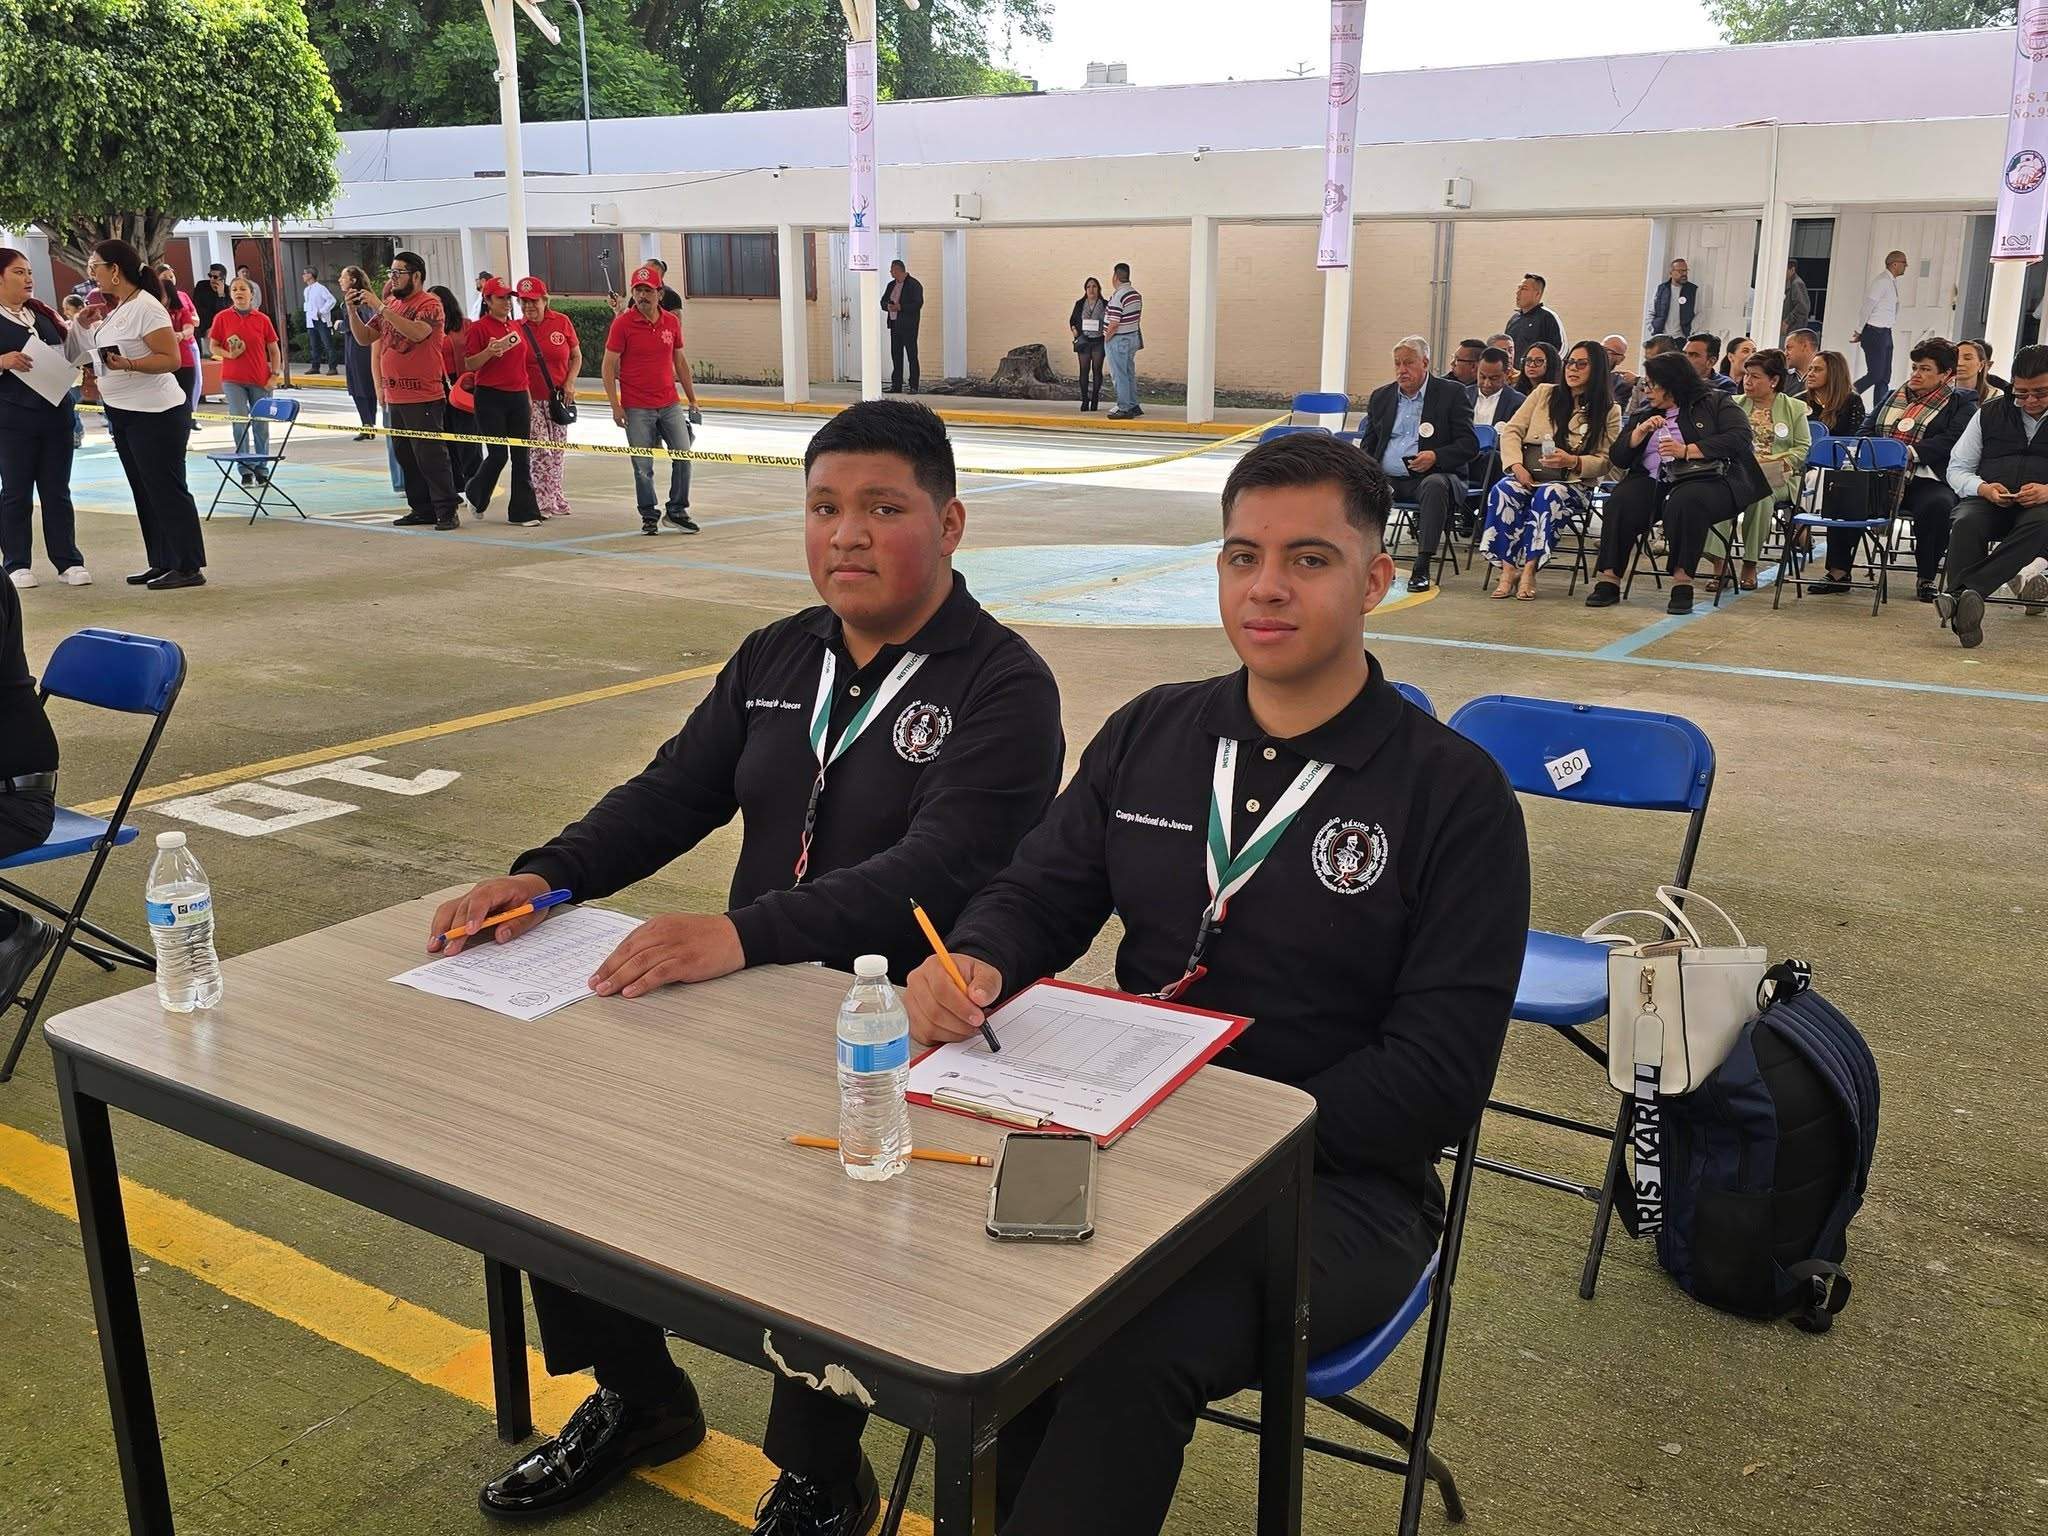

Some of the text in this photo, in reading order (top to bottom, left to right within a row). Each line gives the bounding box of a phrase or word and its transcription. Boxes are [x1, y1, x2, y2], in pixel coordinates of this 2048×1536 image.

[592, 445, 653, 456] PRECAUCION
[667, 449, 732, 462] PRECAUCION
[1552, 756, 1583, 780] 180
[1168, 820, 1192, 831] Jueces
[1341, 819, 1369, 832] MÉXICO
[1636, 1088, 1660, 1165] KARL
